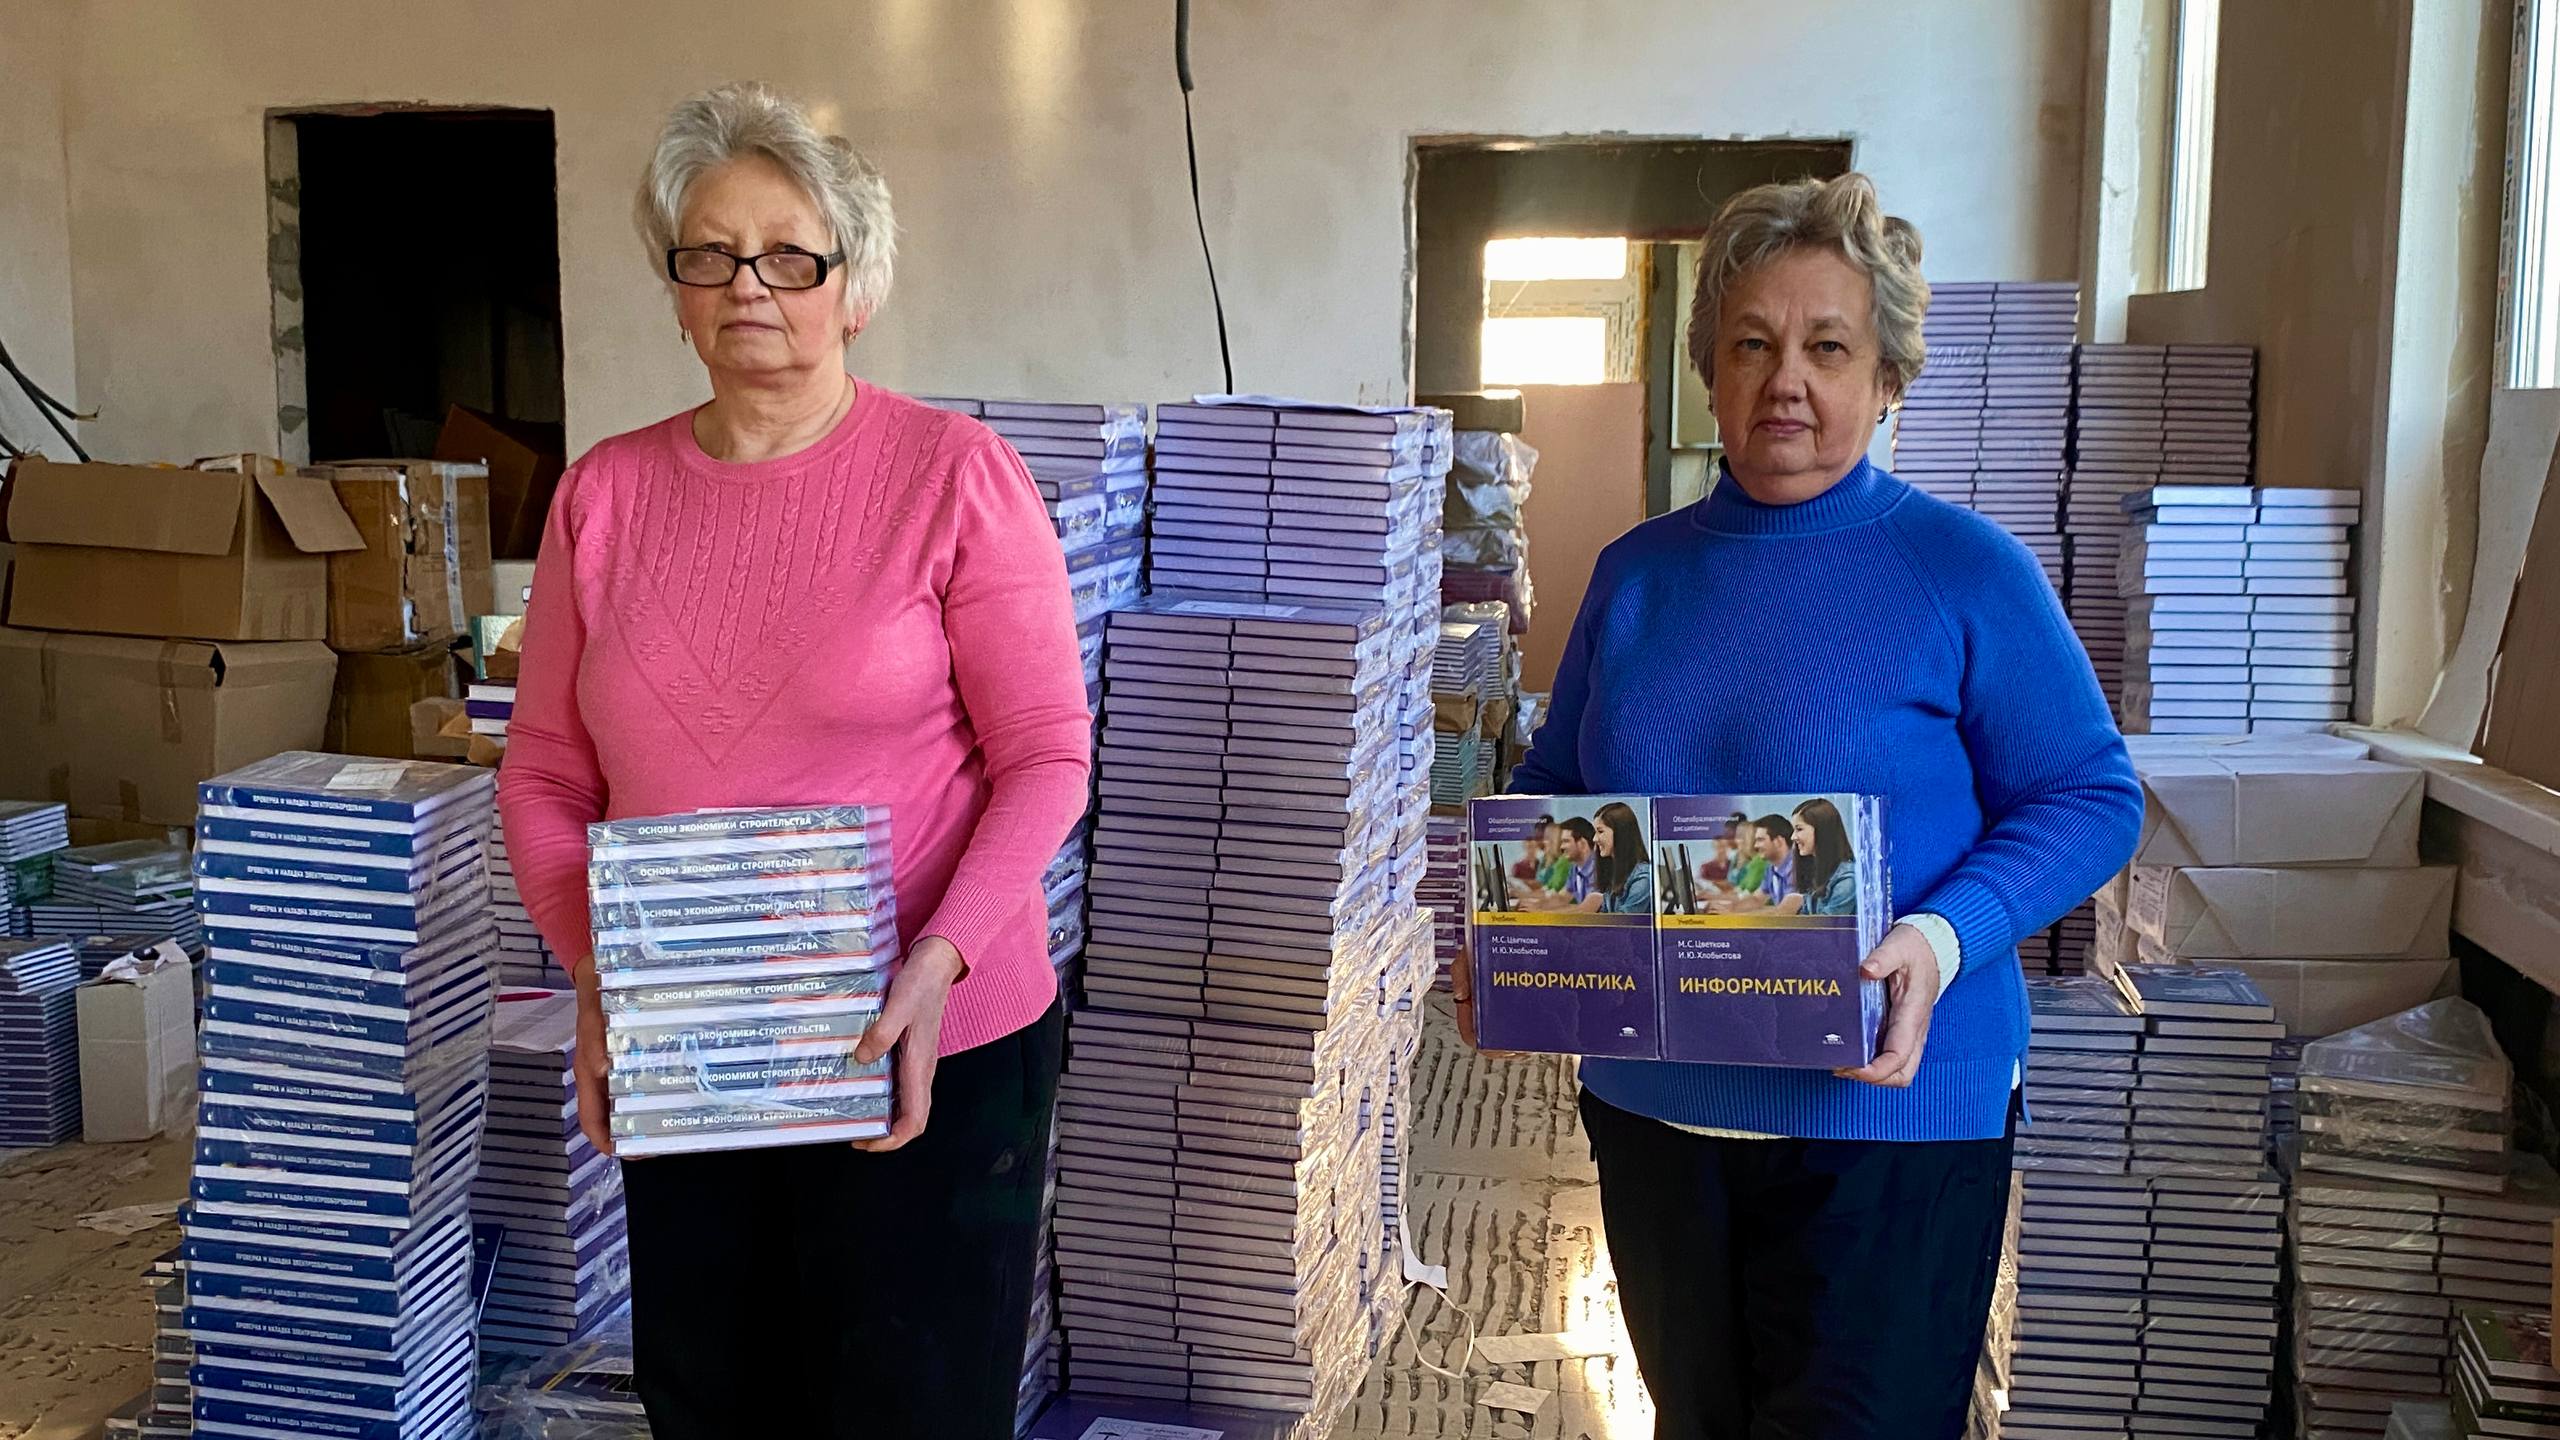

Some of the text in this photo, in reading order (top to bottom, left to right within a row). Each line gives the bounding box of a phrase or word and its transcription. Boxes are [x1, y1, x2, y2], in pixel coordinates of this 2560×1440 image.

[638, 817, 812, 835] ОСНОВЫ ЭКОНОМИКИ СТРОИТЕЛЬСТВА
[640, 858, 813, 877] ОСНОВЫ ЭКОНОМИКИ СТРОИТЕЛЬСТВА
[644, 900, 816, 919] ОСНОВЫ ЭКОНОМИКИ СТРОИЛЬСТВА
[1695, 940, 1730, 949] Цветкова
[1697, 952, 1742, 960] Хлобыстова
[1493, 971, 1636, 991] ИНФОРМАТИКА
[1680, 977, 1841, 996] ИНФОРМАТИКА
[654, 982, 826, 1001] ОСНОВЫ ЭКОНОМИКИ СТРОИТЕЛЬСТВА
[699, 1029, 756, 1040] ЭКОНОМИКИ
[759, 1024, 830, 1036] СТРОИТЕЛЬСТВА
[705, 1071, 758, 1083] КОНОМИКИ
[761, 1066, 833, 1079] СТРОИТЕЛЬСТВА
[662, 1118, 700, 1127] ОСНОВЫ
[703, 1113, 760, 1124] ЭКОНОМИКИ
